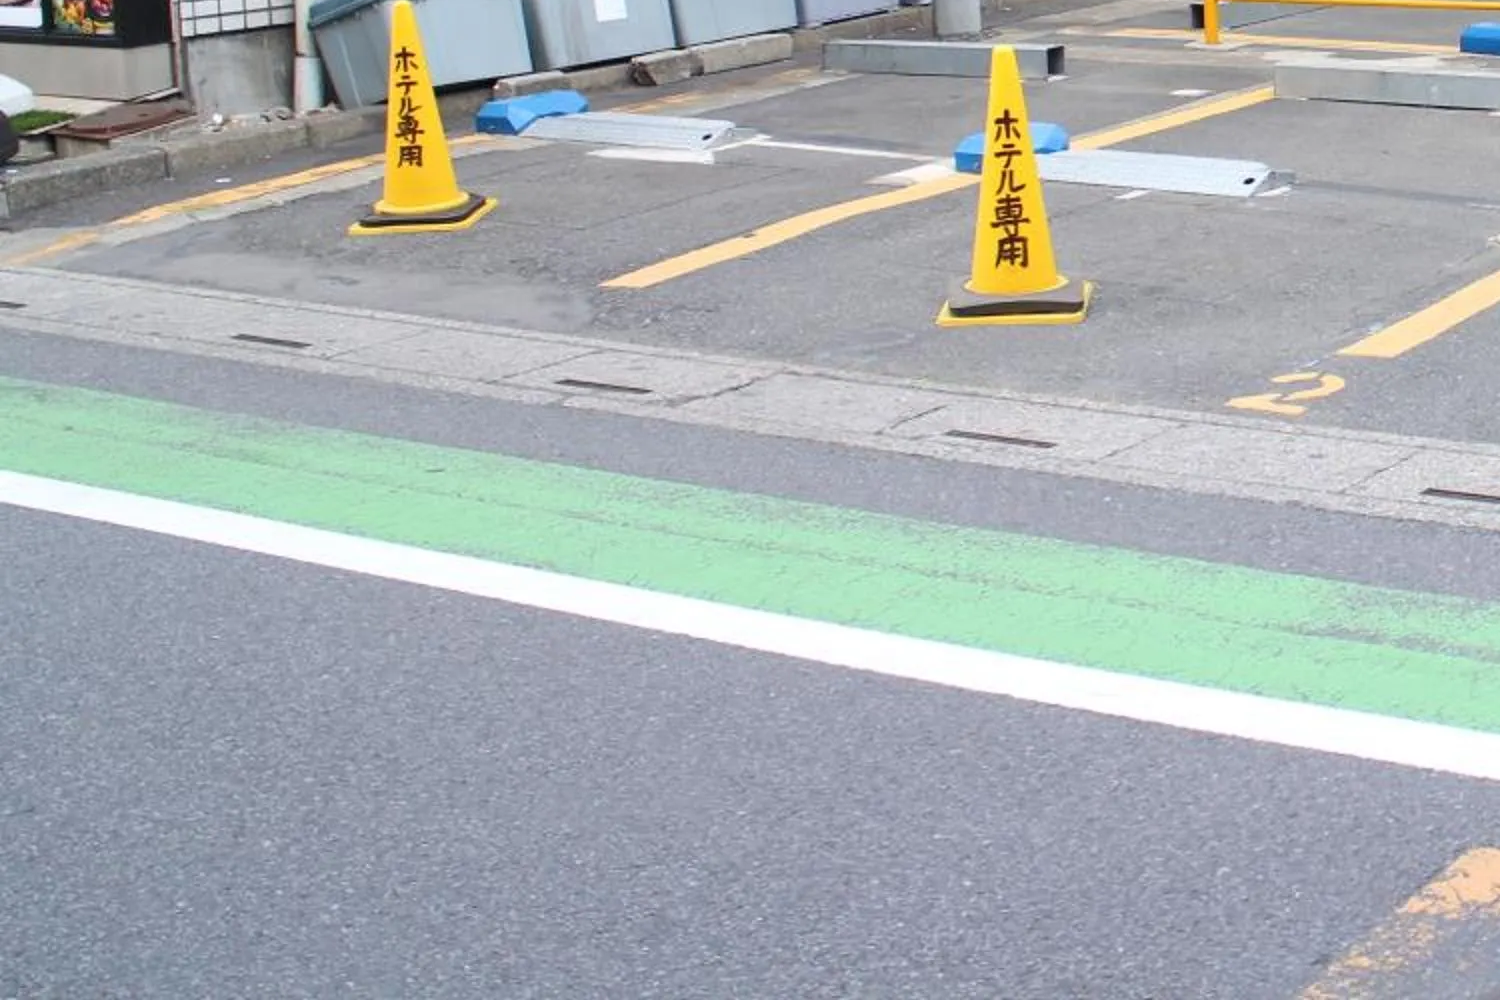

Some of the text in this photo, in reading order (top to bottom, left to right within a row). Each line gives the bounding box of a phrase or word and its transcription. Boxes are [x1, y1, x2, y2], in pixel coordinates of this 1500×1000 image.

[393, 47, 425, 168] ホテル専用
[990, 108, 1031, 269] ホテル専用
[1224, 371, 1345, 416] 2
